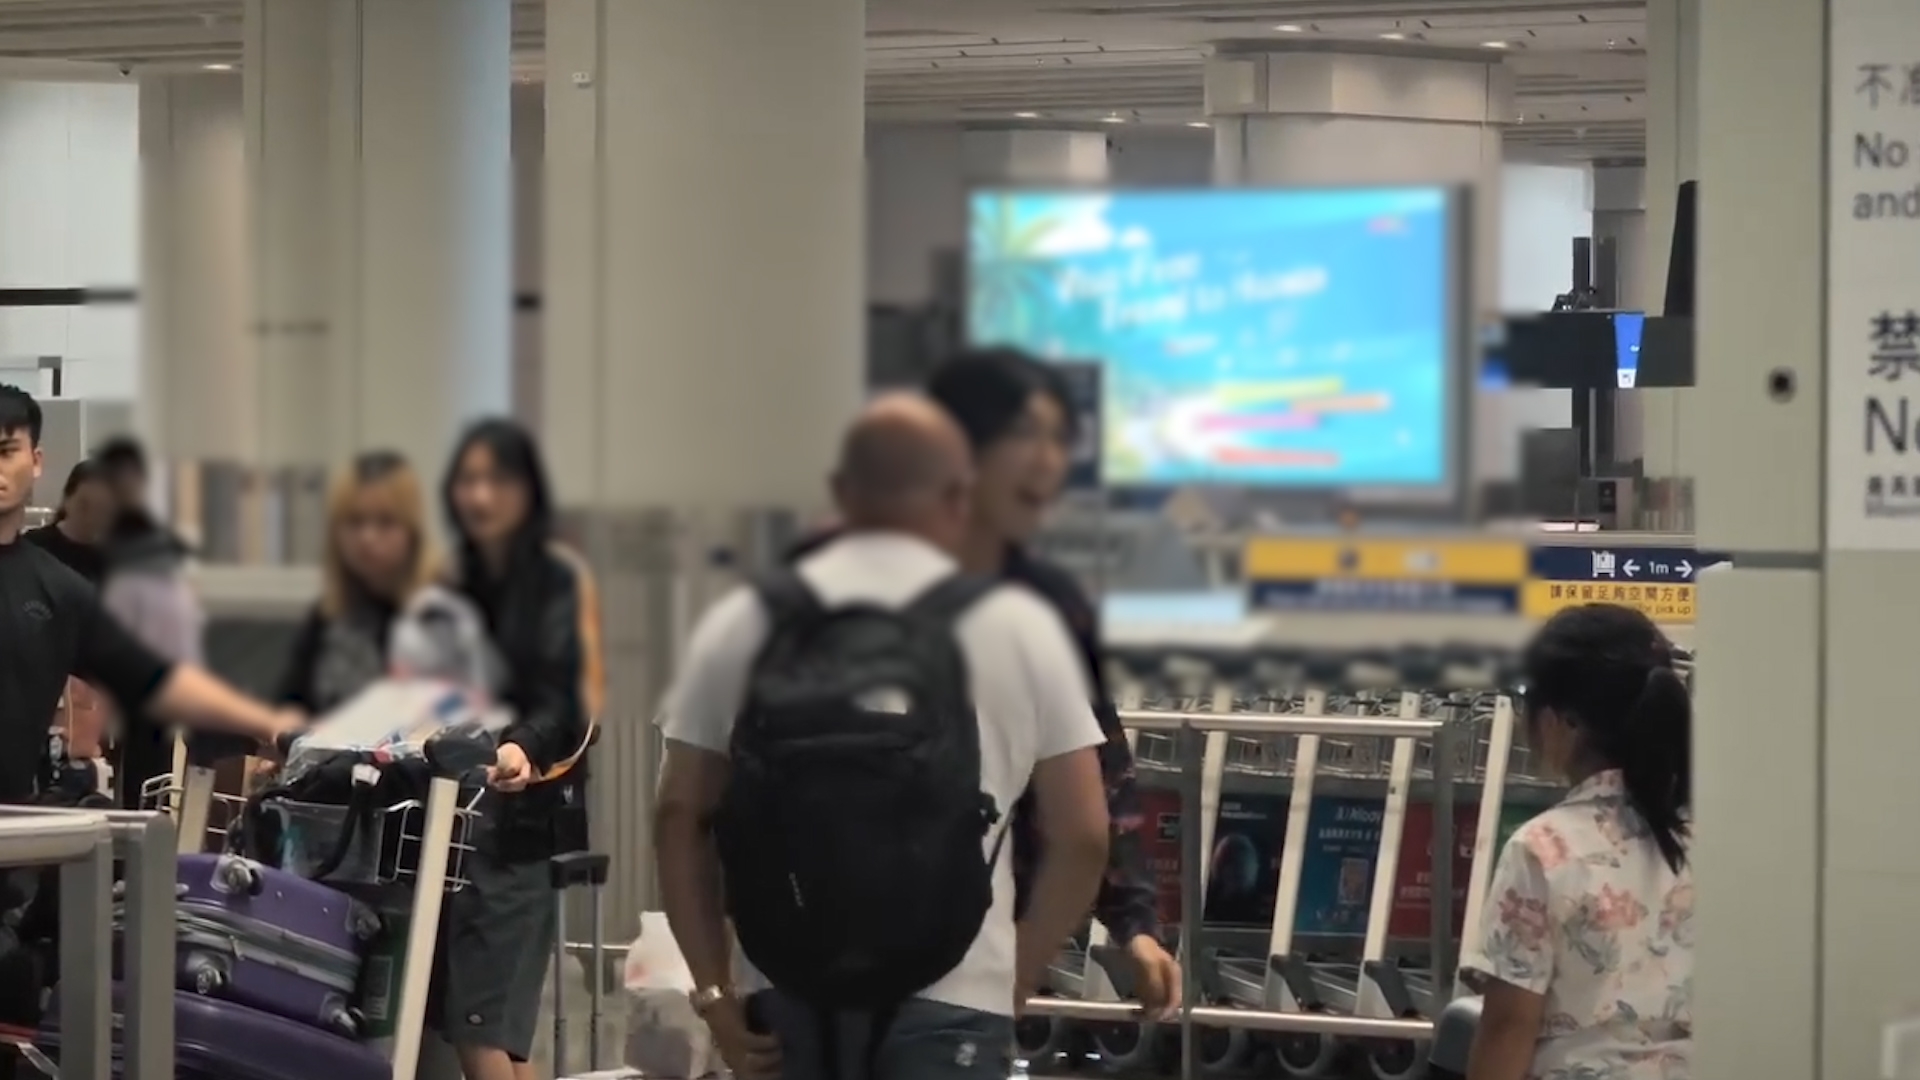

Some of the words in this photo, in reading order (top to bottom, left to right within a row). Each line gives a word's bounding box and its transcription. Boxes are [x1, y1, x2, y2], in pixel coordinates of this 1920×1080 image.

[1854, 131, 1909, 168] No
[1865, 397, 1920, 453] N
[1649, 561, 1670, 575] 1m
[1655, 603, 1674, 615] pick
[1677, 605, 1691, 615] up
